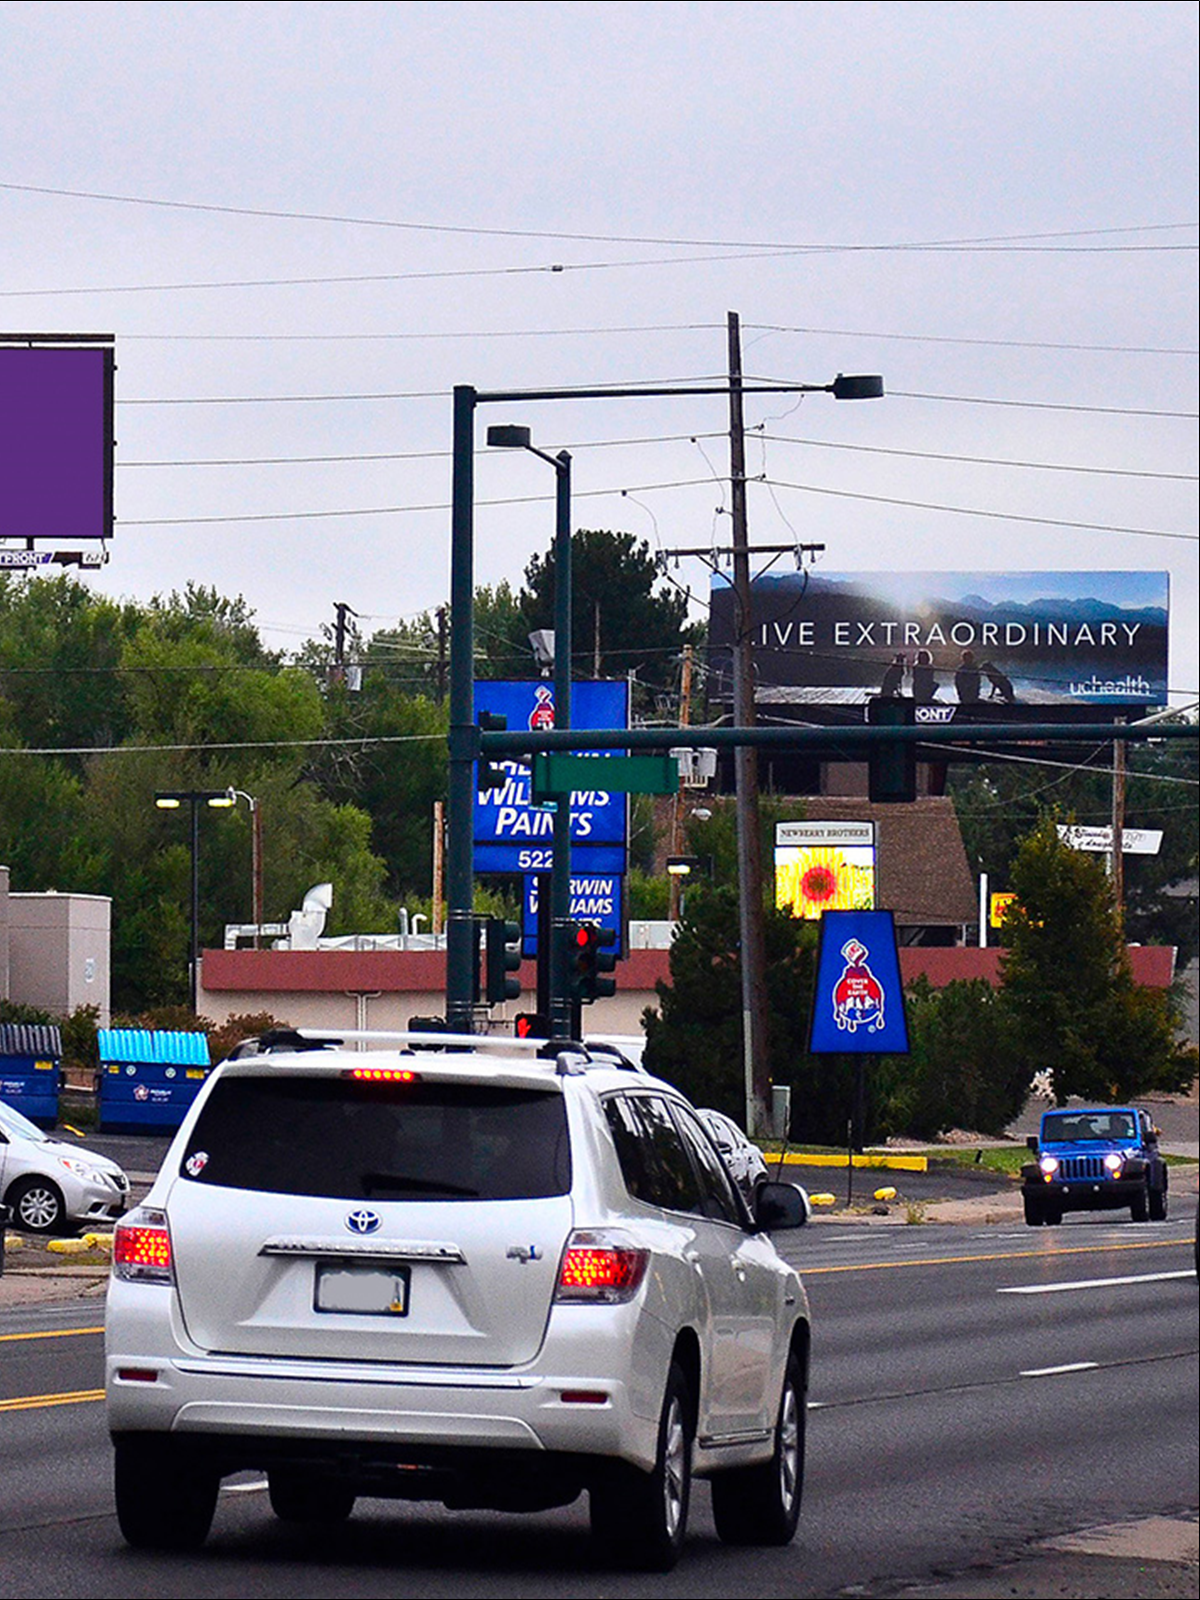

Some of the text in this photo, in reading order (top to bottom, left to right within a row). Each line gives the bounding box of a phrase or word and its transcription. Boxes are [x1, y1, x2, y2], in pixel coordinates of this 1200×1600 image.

[751, 621, 1141, 646] IVE EXTRAORDINARY
[1069, 675, 1151, 696] uchealth
[826, 828, 870, 837] BROTHERS
